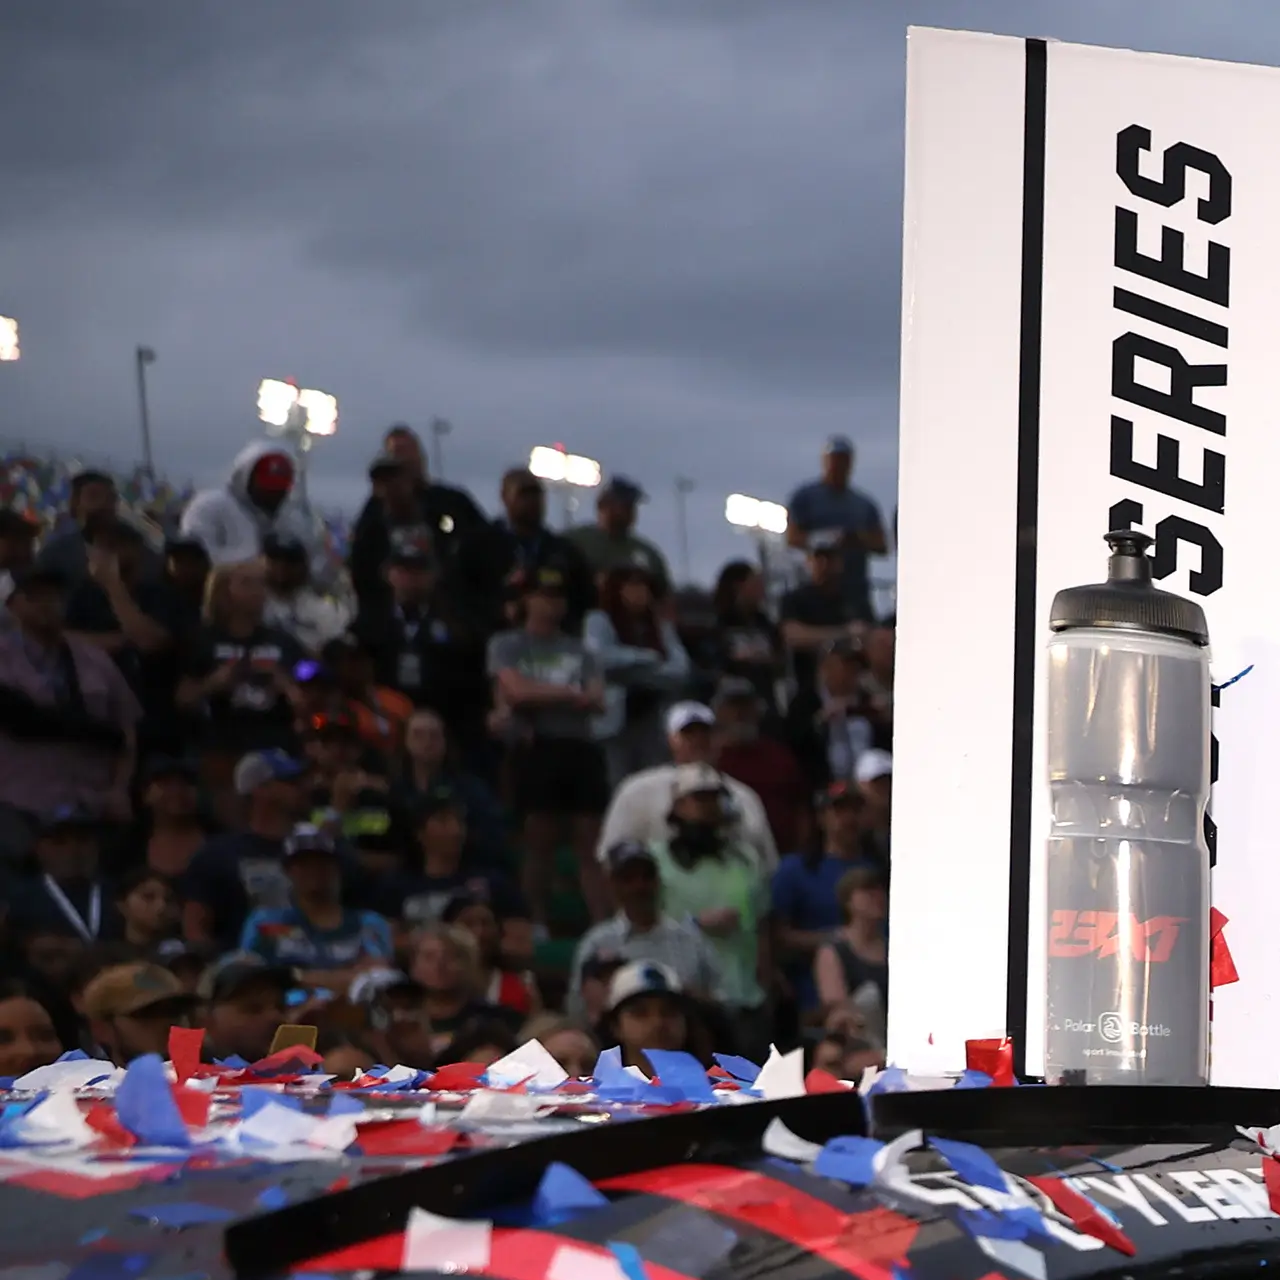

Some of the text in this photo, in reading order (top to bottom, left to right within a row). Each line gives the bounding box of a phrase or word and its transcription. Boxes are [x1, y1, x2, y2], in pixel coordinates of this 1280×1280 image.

[1108, 123, 1232, 597] SERIES
[1064, 1018, 1172, 1037] Polar Bottle
